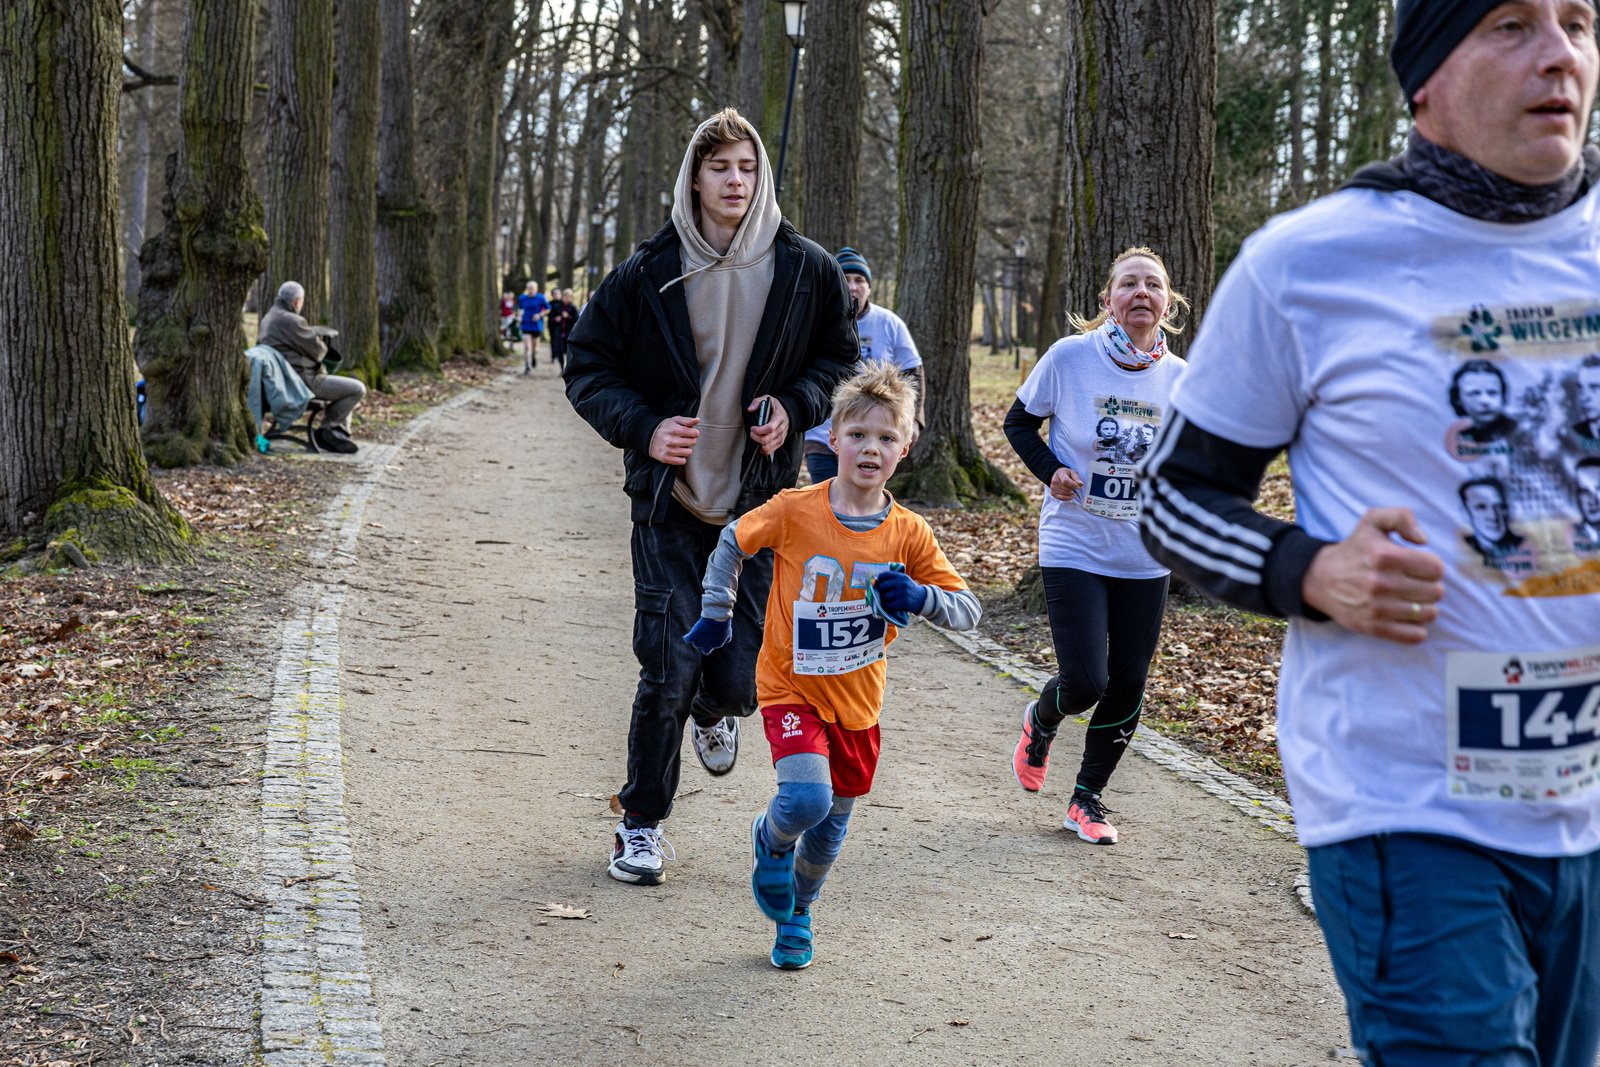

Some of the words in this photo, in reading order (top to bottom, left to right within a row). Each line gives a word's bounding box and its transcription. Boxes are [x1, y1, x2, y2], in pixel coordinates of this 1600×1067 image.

[1505, 305, 1555, 319] TROPEM
[1122, 405, 1153, 418] WILCZYM
[815, 618, 870, 648] 152
[1491, 685, 1600, 747] 144
[782, 729, 803, 739] POLSKA
